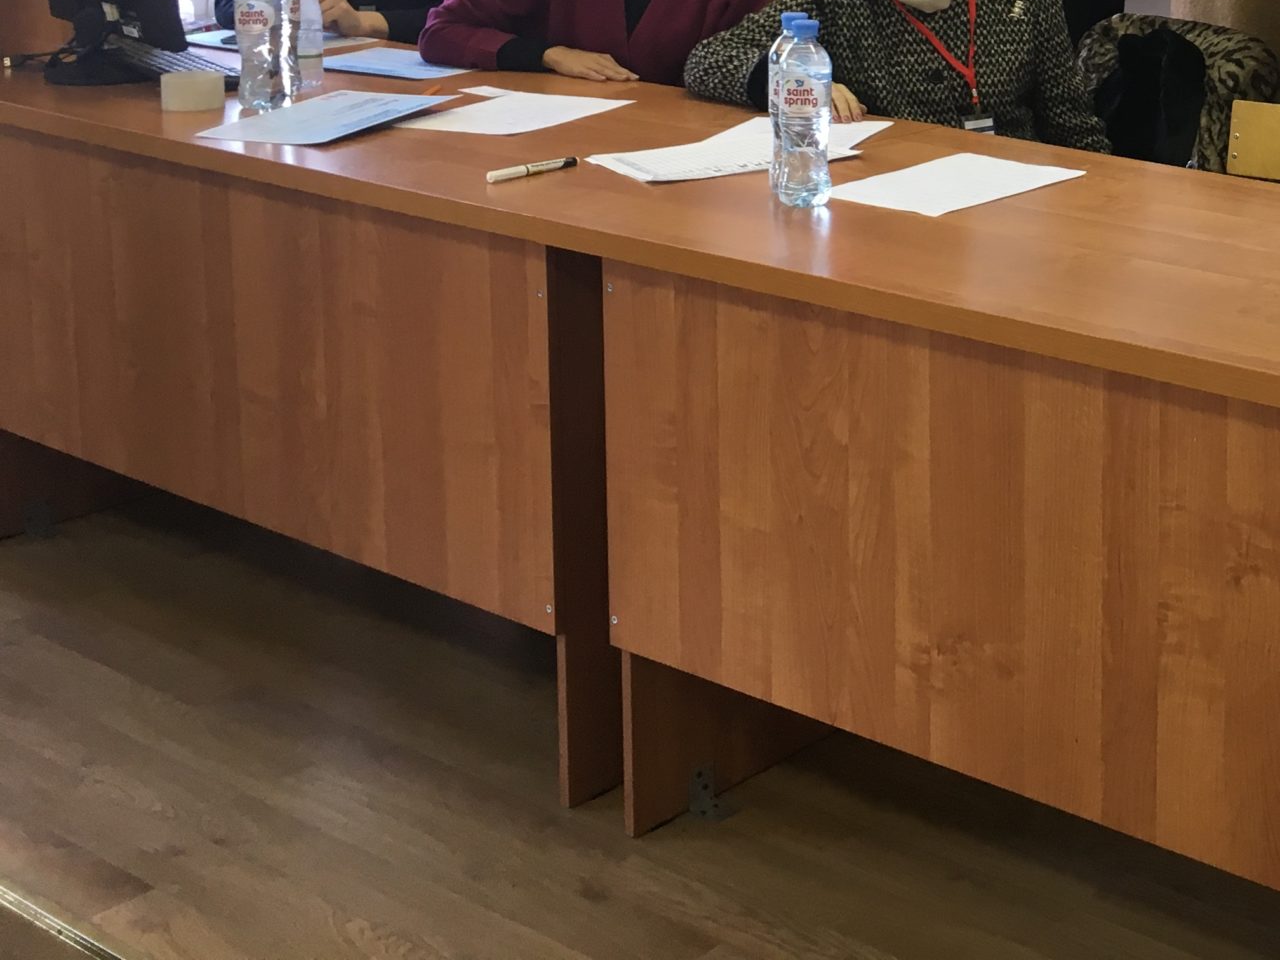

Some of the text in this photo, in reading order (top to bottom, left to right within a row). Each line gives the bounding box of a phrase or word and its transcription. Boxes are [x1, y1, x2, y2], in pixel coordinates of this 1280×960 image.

[238, 18, 268, 27] spring
[786, 88, 814, 96] saint
[784, 96, 818, 108] spring
